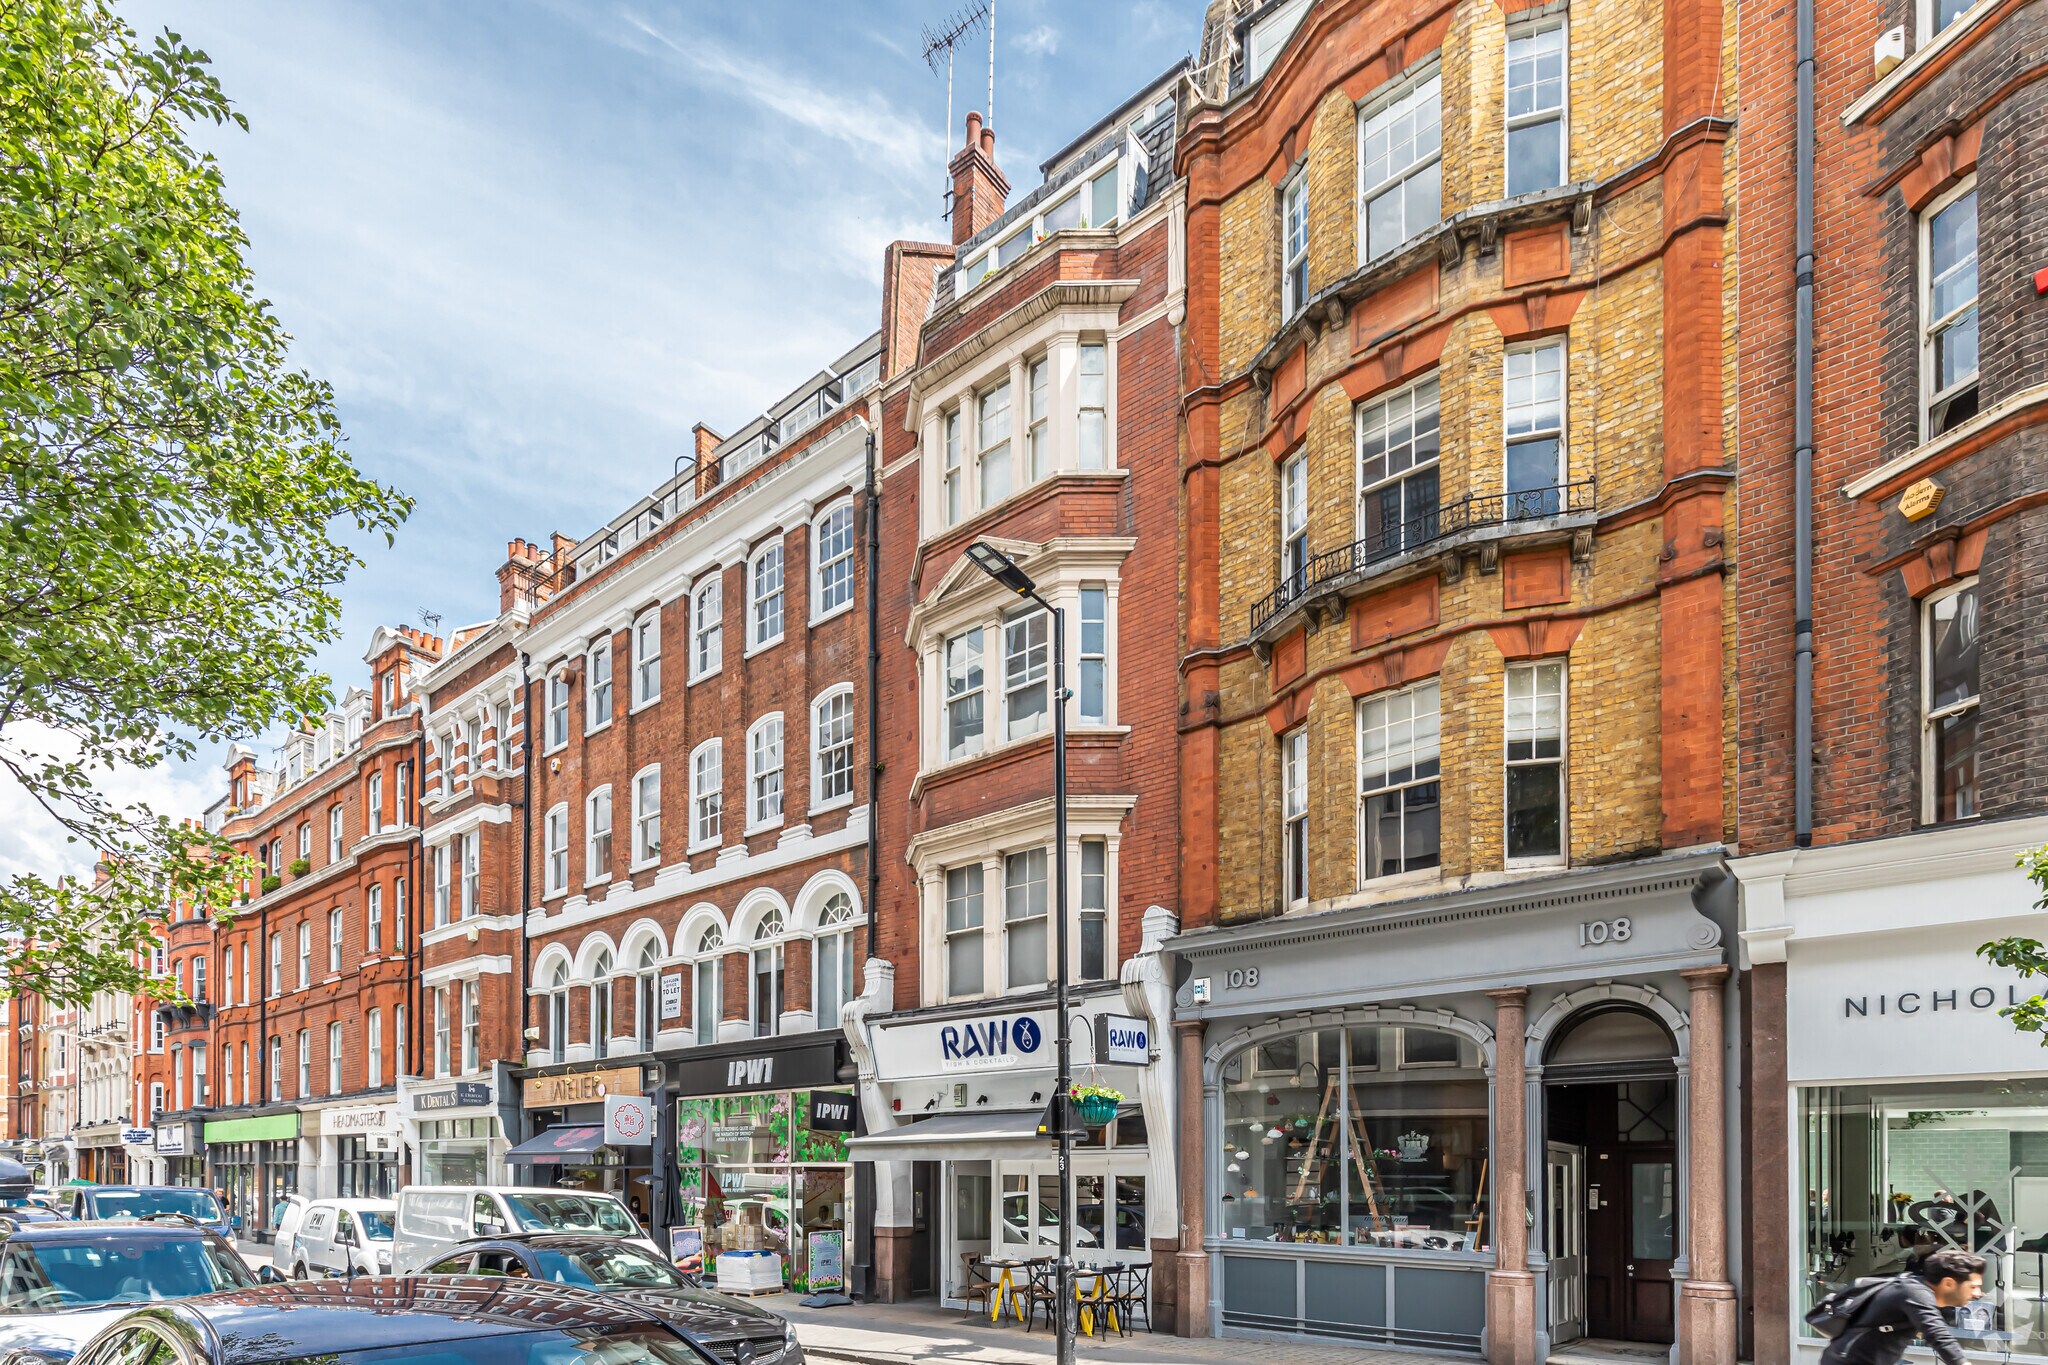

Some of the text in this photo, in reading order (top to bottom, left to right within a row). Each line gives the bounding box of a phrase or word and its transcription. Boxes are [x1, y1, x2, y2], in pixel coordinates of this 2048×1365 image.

[1904, 495, 1930, 510] Alarms
[1580, 917, 1632, 946] 108
[1224, 967, 1260, 990] 108
[1845, 985, 2048, 1018] NICHOL
[941, 1020, 1008, 1060] RAW
[1110, 1029, 1135, 1048] RAW
[974, 1056, 1015, 1065] COCKTAILS
[552, 1076, 601, 1101] ATELIER
[421, 1091, 458, 1108] K DENTAL S
[333, 1111, 380, 1128] HEADMASTERS
